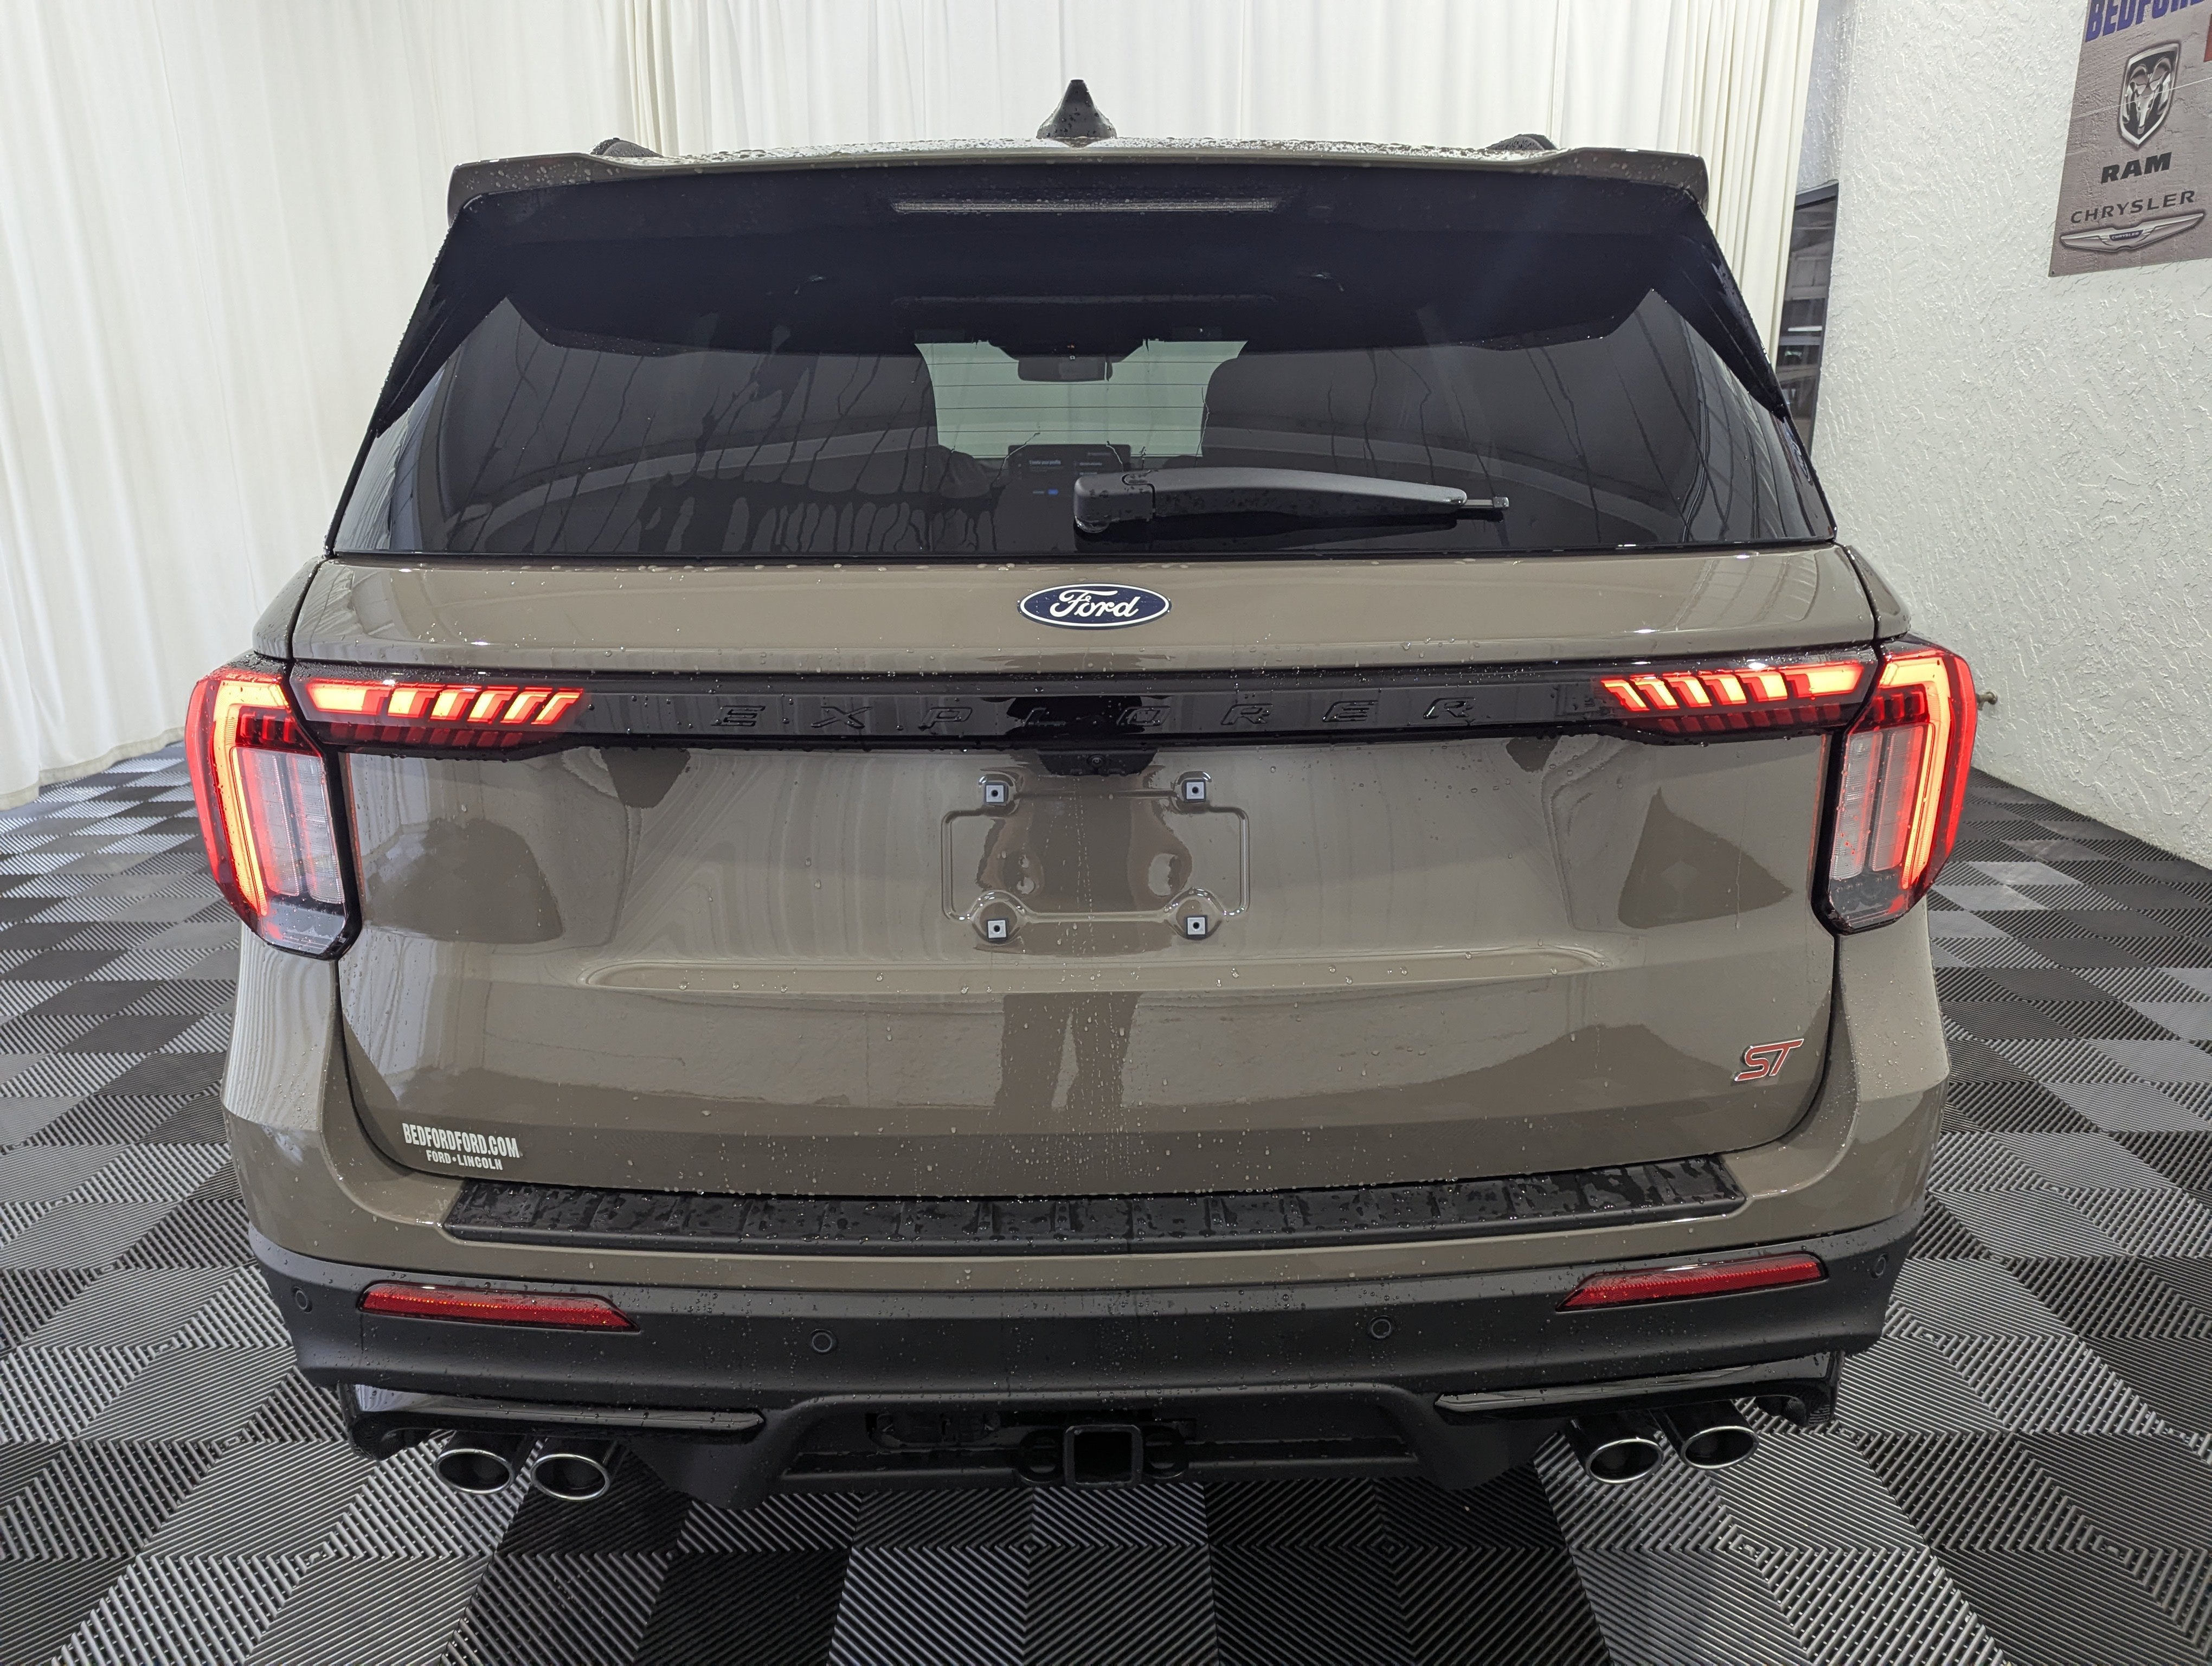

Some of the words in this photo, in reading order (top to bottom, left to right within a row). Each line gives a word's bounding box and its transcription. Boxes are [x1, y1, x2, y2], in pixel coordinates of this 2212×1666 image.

[2101, 152, 2172, 183] RAM
[2071, 190, 2195, 223] CHRYSLER
[1050, 589, 1141, 617] Ford
[710, 697, 1475, 728] EXPLORER
[1734, 1038, 1804, 1081] ST
[402, 1123, 520, 1158] BEDFORDFORD.COM
[426, 1149, 452, 1164] FORD
[456, 1154, 503, 1170] LINCOLN
